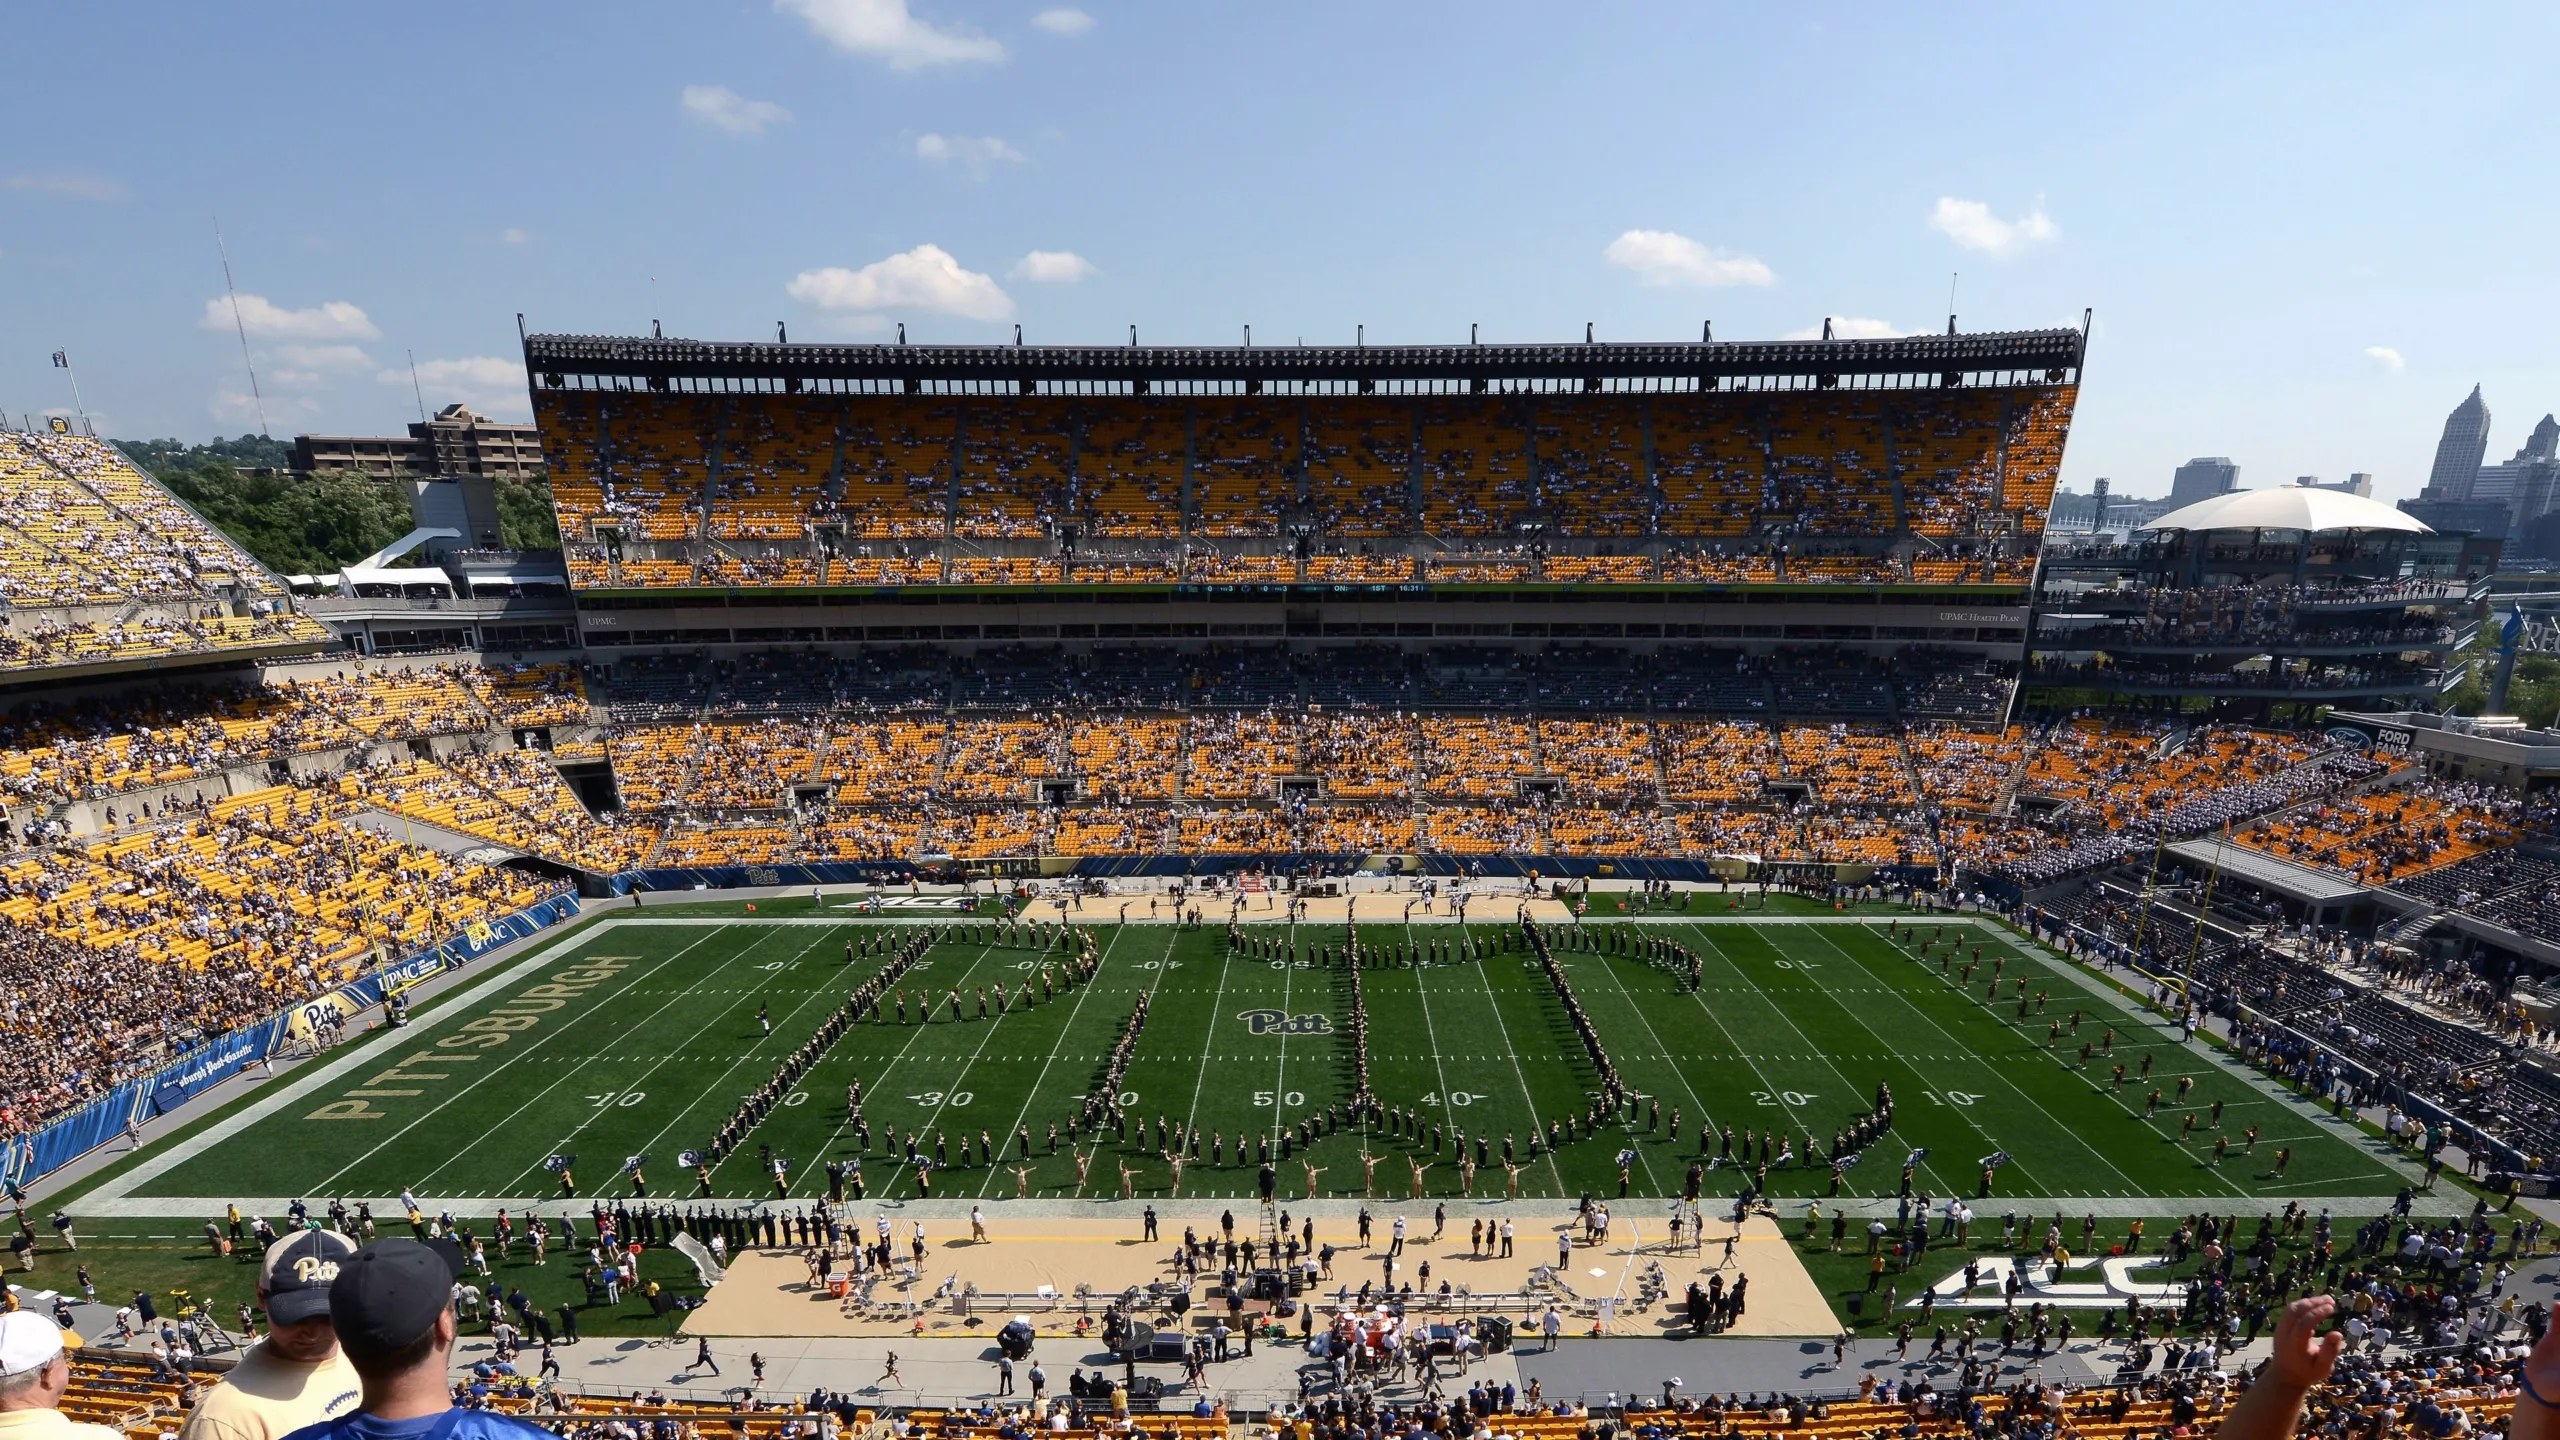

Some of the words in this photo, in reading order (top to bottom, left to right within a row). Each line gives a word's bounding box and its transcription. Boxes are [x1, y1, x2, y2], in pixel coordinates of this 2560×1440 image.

[588, 617, 617, 626] UPMC
[1940, 612, 1968, 621] UPMC
[2378, 729, 2410, 745] FORD
[745, 867, 780, 884] Pitt
[1237, 1009, 1334, 1035] Pitt
[303, 955, 643, 1119] PITTSBURGH
[592, 1092, 646, 1107] 10
[918, 1091, 974, 1107] 30
[1253, 1091, 1305, 1107] 50
[1420, 1091, 1473, 1106] 40
[1750, 1091, 1808, 1106] 20
[1921, 1091, 1974, 1106] 10
[292, 1256, 341, 1283] Pitt
[1918, 1256, 2188, 1300] ACC
